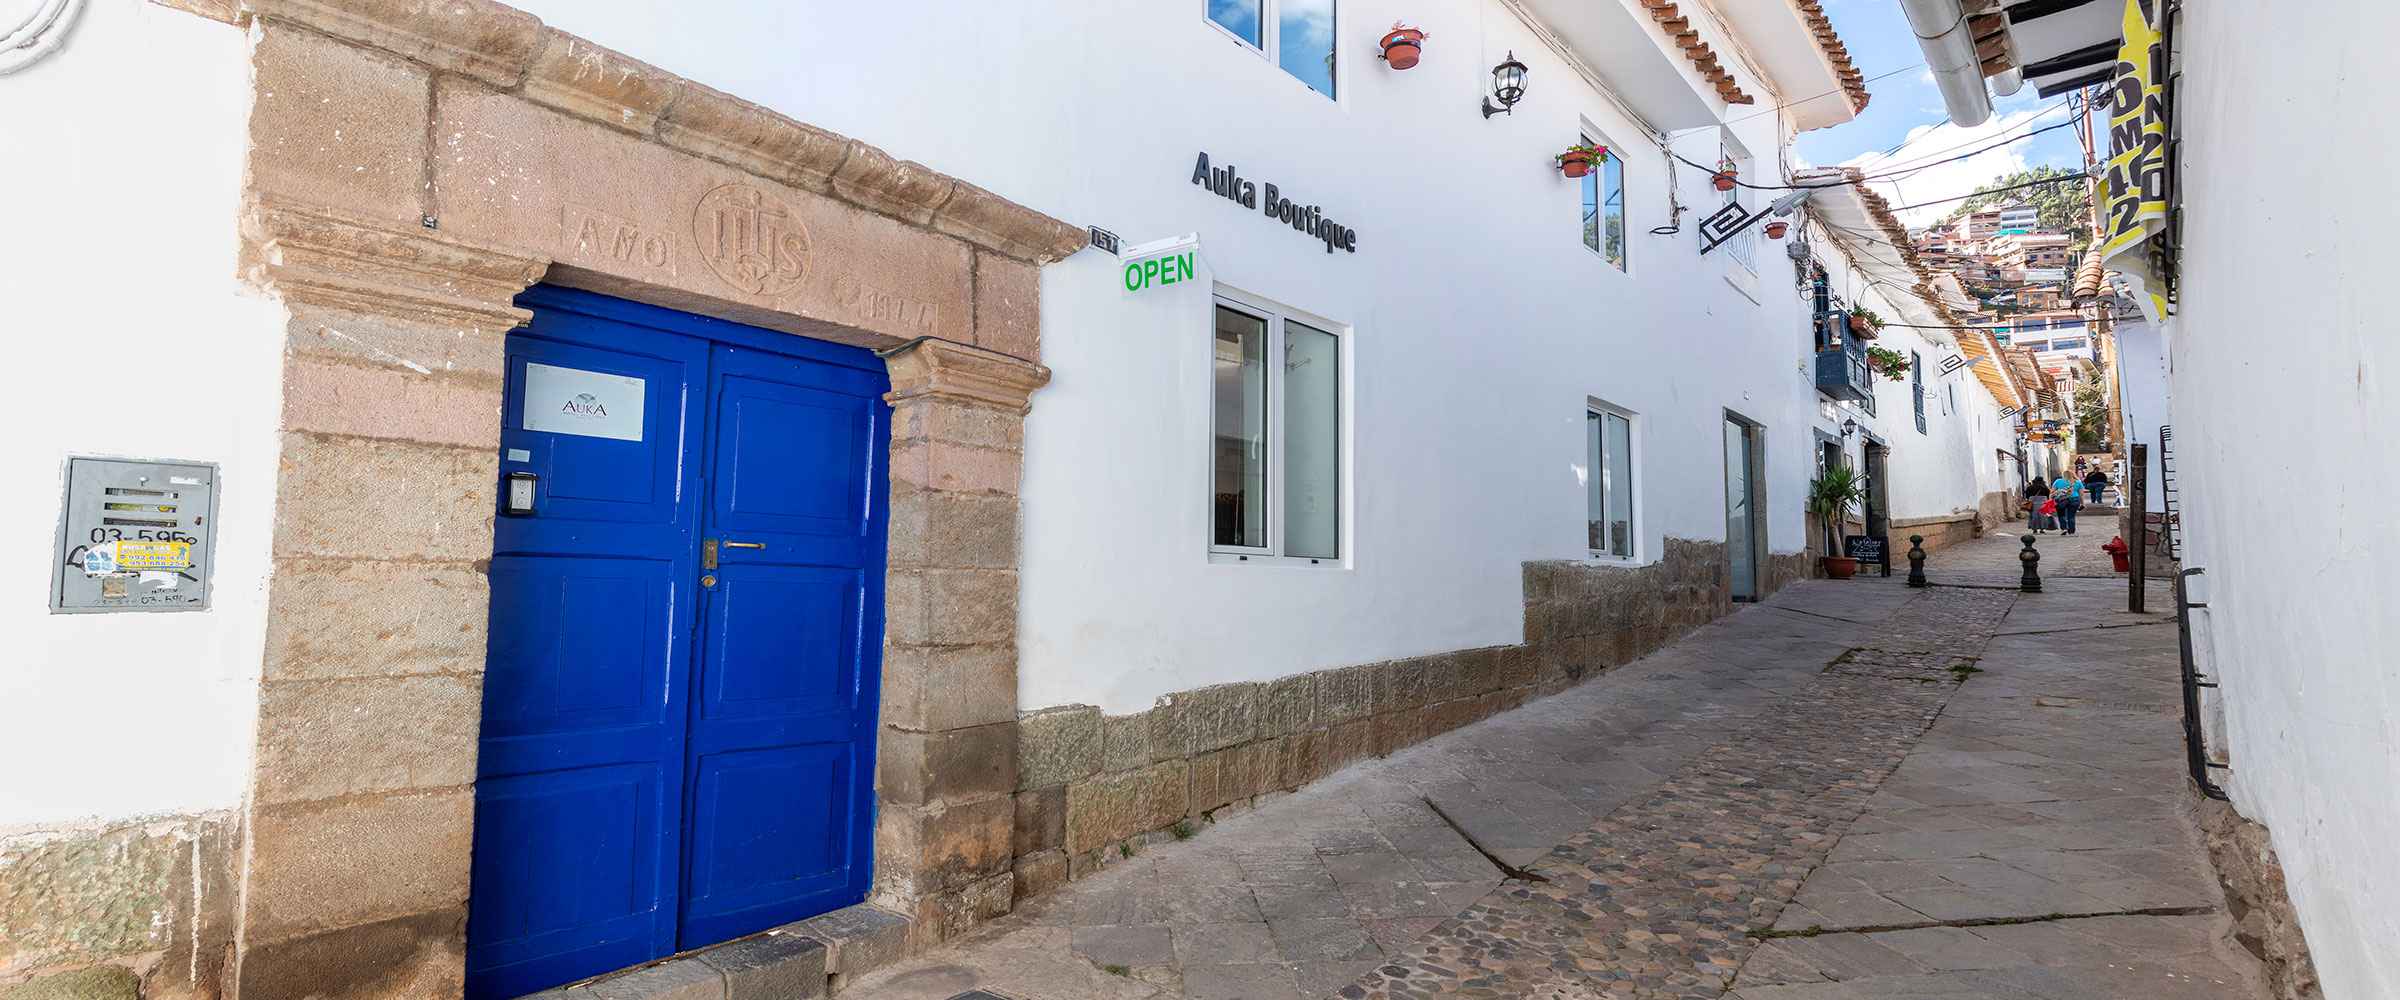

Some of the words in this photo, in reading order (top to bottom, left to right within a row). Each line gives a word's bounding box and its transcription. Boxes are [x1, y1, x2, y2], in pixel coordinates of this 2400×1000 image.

[1192, 151, 1257, 210] Auka
[1265, 182, 1356, 254] Boutique
[1125, 252, 1194, 292] OPEN
[562, 400, 607, 416] AUKA
